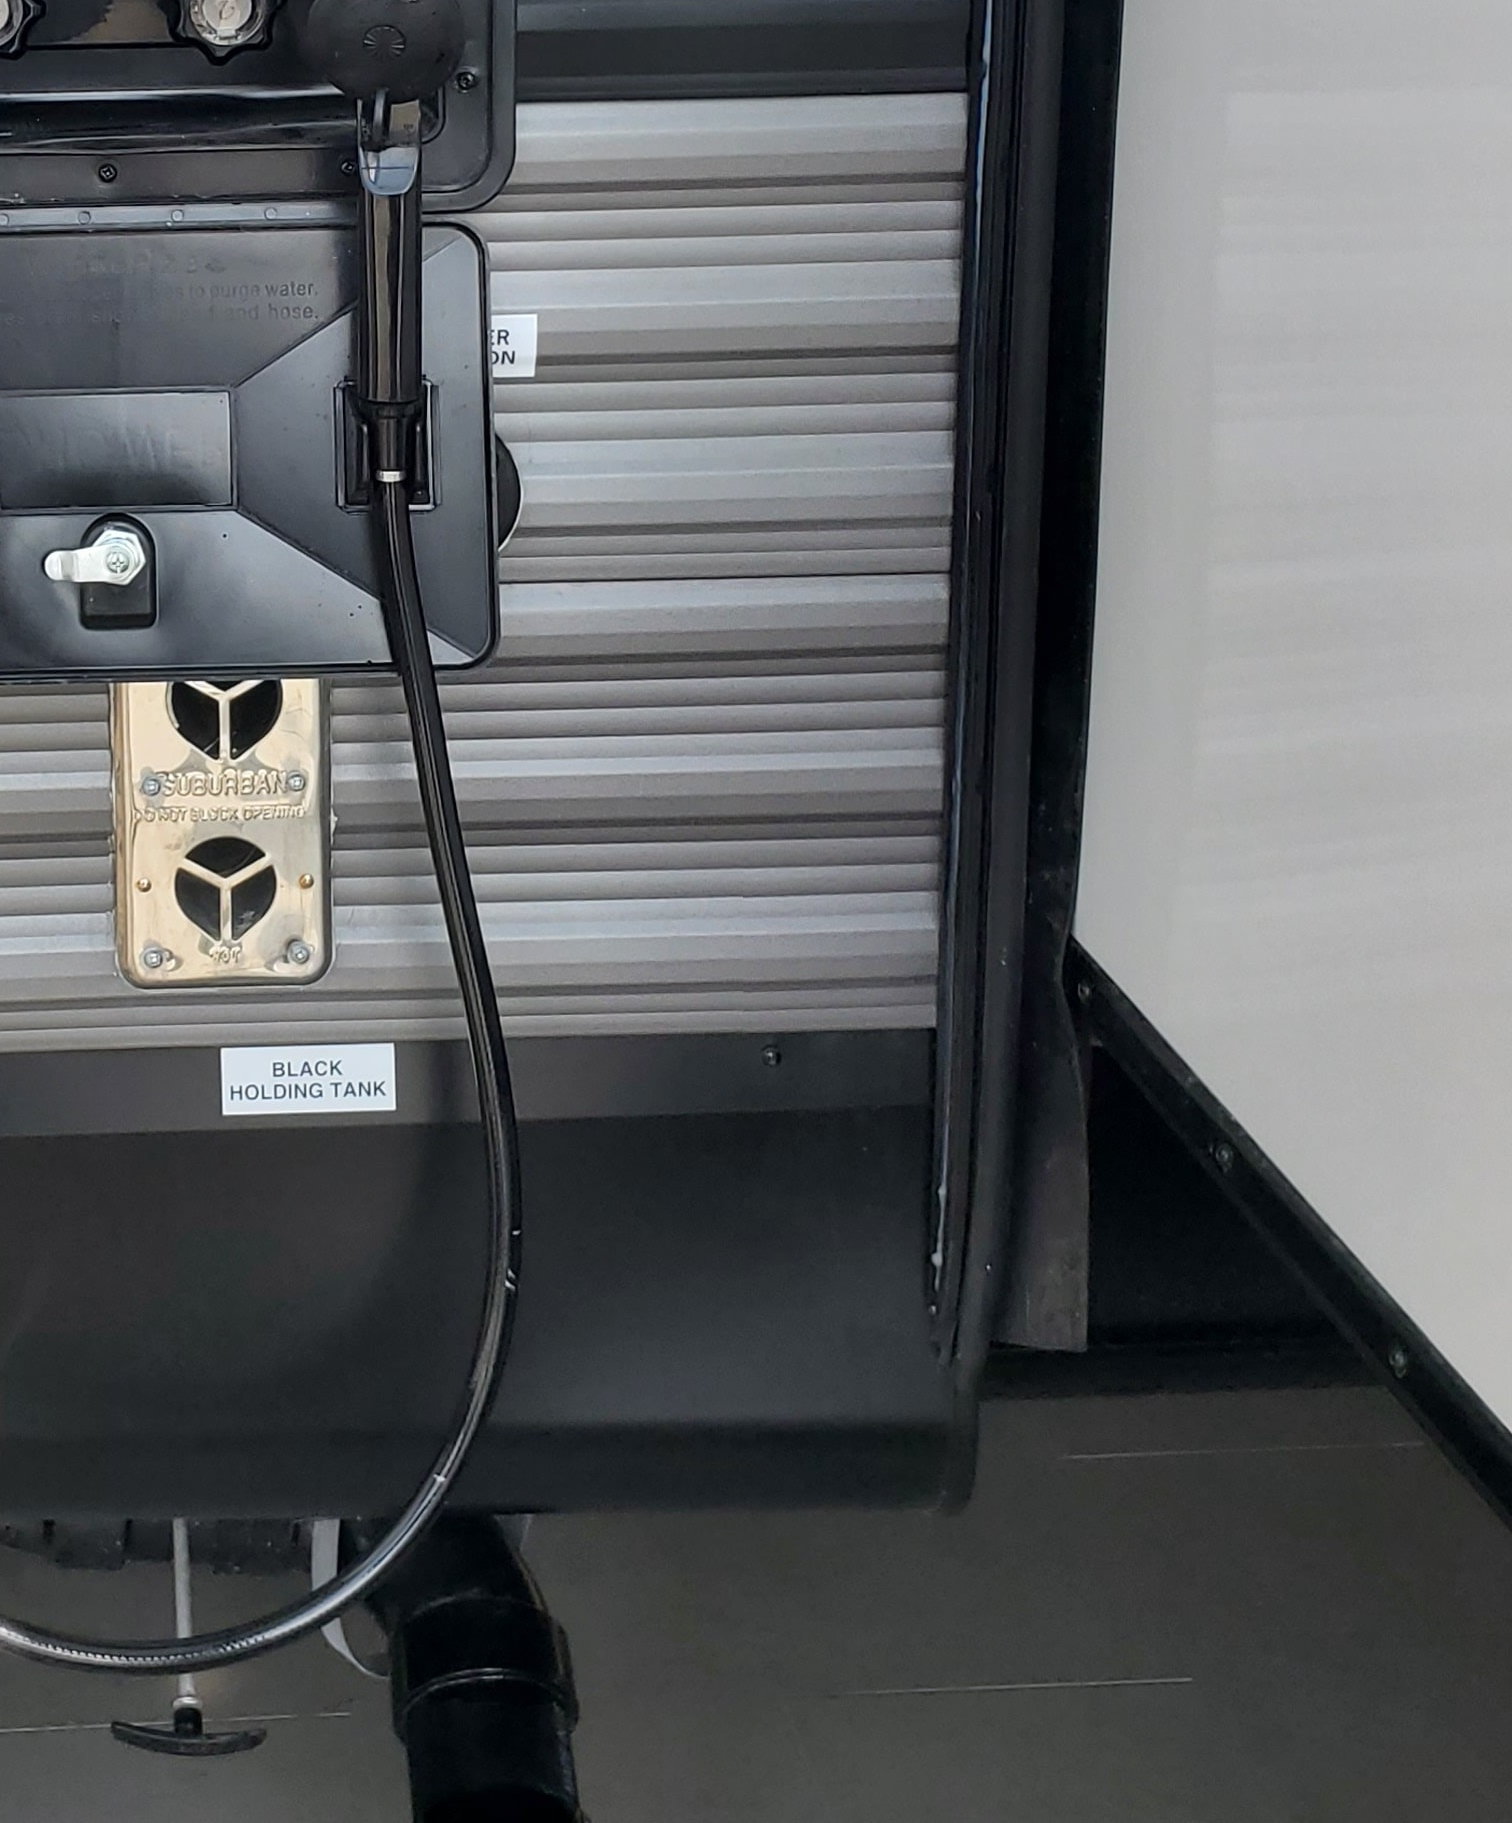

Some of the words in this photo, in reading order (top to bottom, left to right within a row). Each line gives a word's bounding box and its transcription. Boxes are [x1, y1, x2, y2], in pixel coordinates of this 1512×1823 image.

[265, 280, 319, 297] water.
[268, 303, 319, 320] hose.
[162, 769, 288, 796] SUBURBAN
[158, 807, 187, 822] NOT
[190, 806, 239, 822] BLOCK
[272, 1060, 343, 1077] BLACK
[230, 1083, 324, 1101] HOLDING
[330, 1081, 387, 1098] TANK
